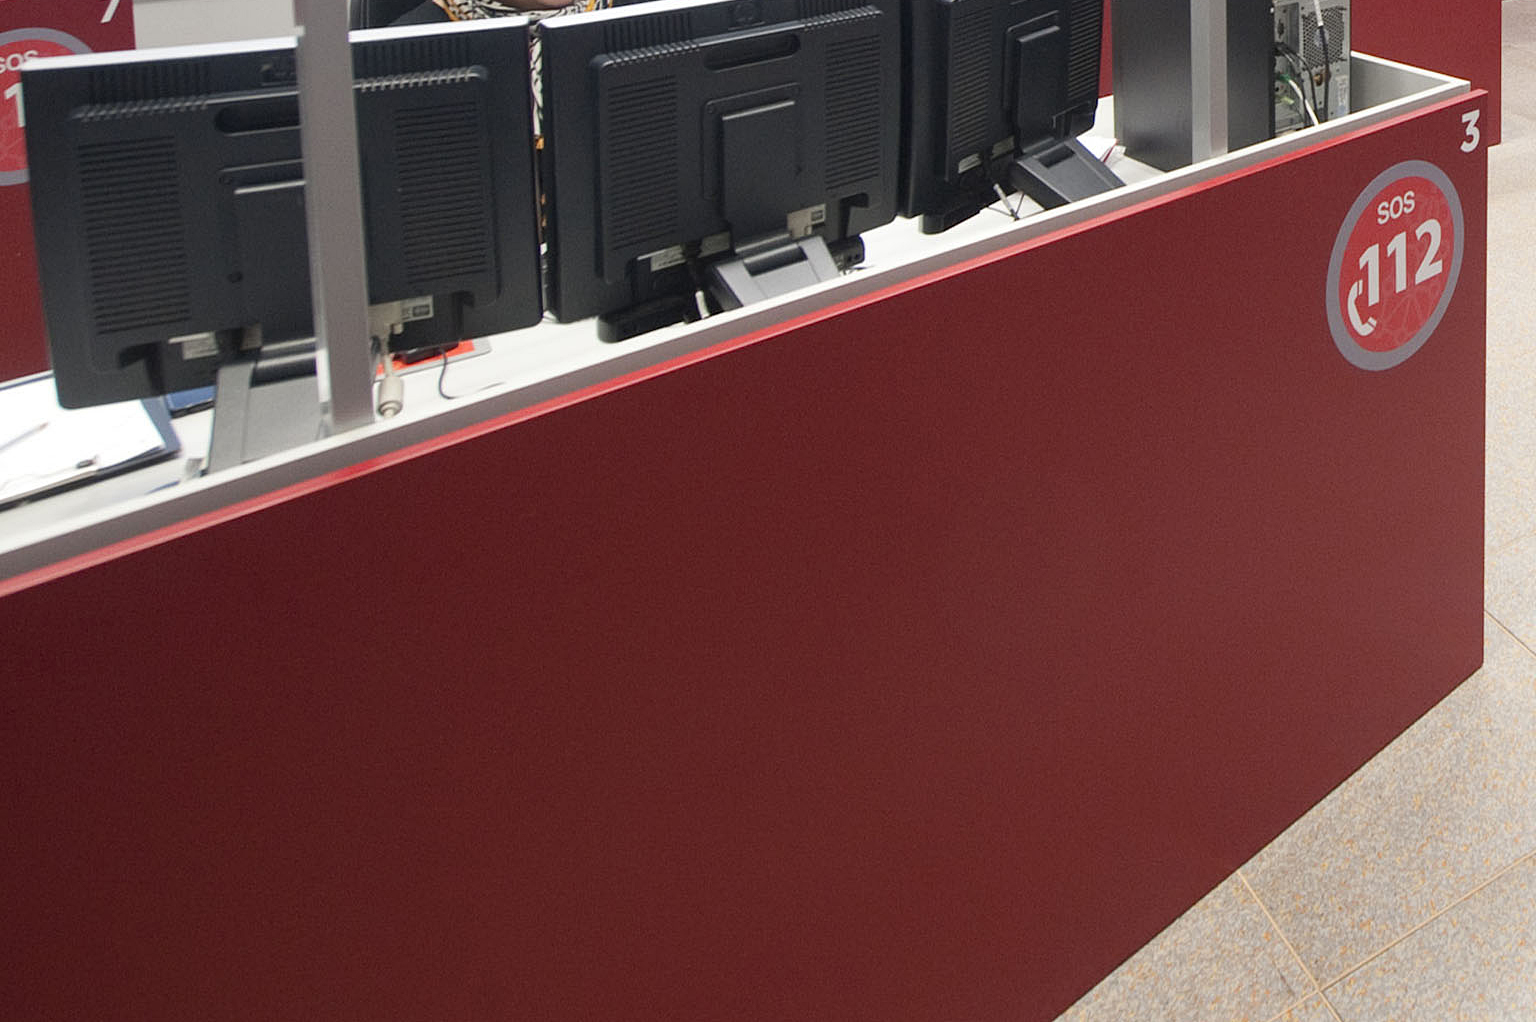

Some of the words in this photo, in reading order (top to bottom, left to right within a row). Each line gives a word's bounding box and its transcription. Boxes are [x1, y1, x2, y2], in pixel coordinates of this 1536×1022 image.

[1460, 109, 1480, 153] 3
[1377, 190, 1415, 225] SOS
[1359, 218, 1443, 307] 112
